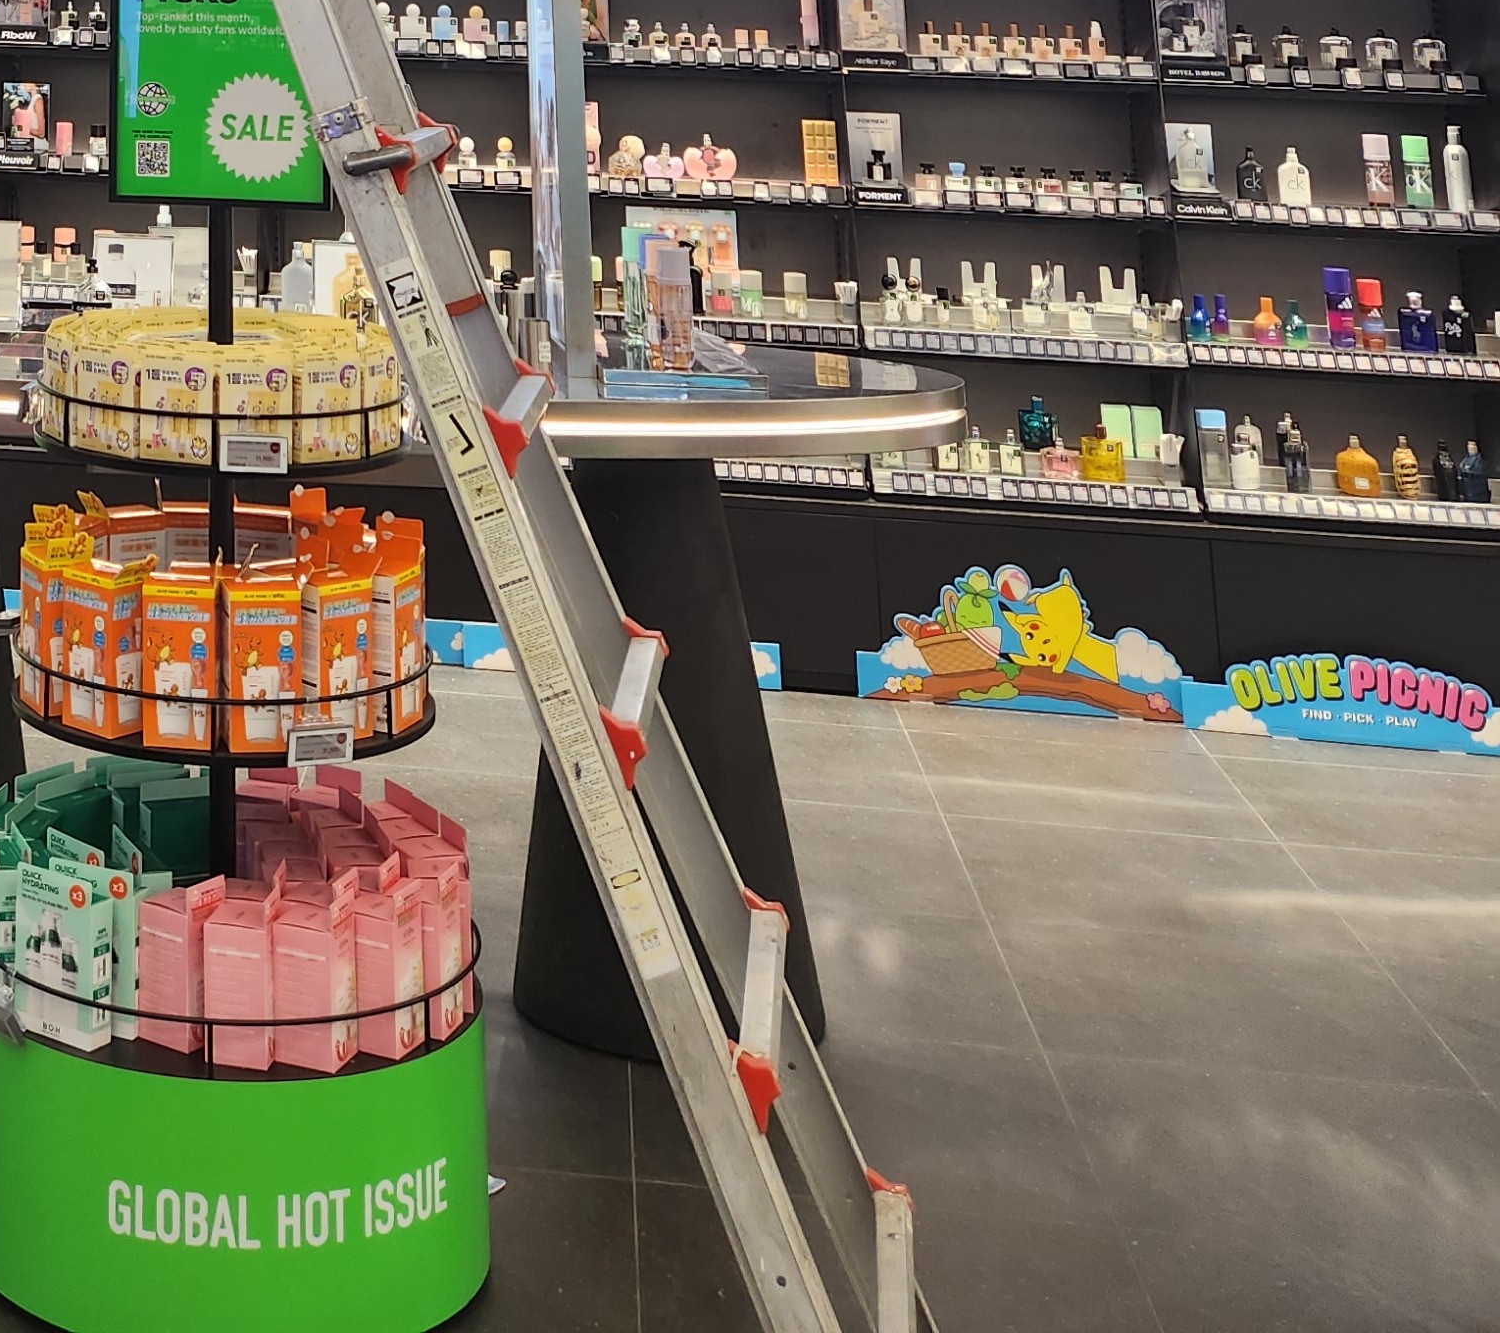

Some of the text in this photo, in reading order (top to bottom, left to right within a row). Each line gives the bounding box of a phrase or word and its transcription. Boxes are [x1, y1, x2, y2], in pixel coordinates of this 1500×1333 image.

[136, 11, 193, 24] Top-ranked
[195, 12, 215, 23] this
[164, 24, 176, 35] by
[178, 25, 213, 37] beauty
[215, 25, 237, 35] fans
[219, 114, 295, 142] SALE
[1243, 171, 1262, 190] ck
[858, 190, 903, 202] FORMENT
[1176, 202, 1229, 216] Calvin Klein
[1230, 658, 1488, 731] OLIVE PICNIC
[1302, 708, 1418, 728] FIND PICK PLAY
[22, 868, 42, 881] QUICK
[55, 864, 78, 876] QUICK
[22, 877, 60, 895] HYDRATING
[71, 891, 83, 902] x3
[107, 1156, 448, 1250] GLOBAL HOT ISSUE
